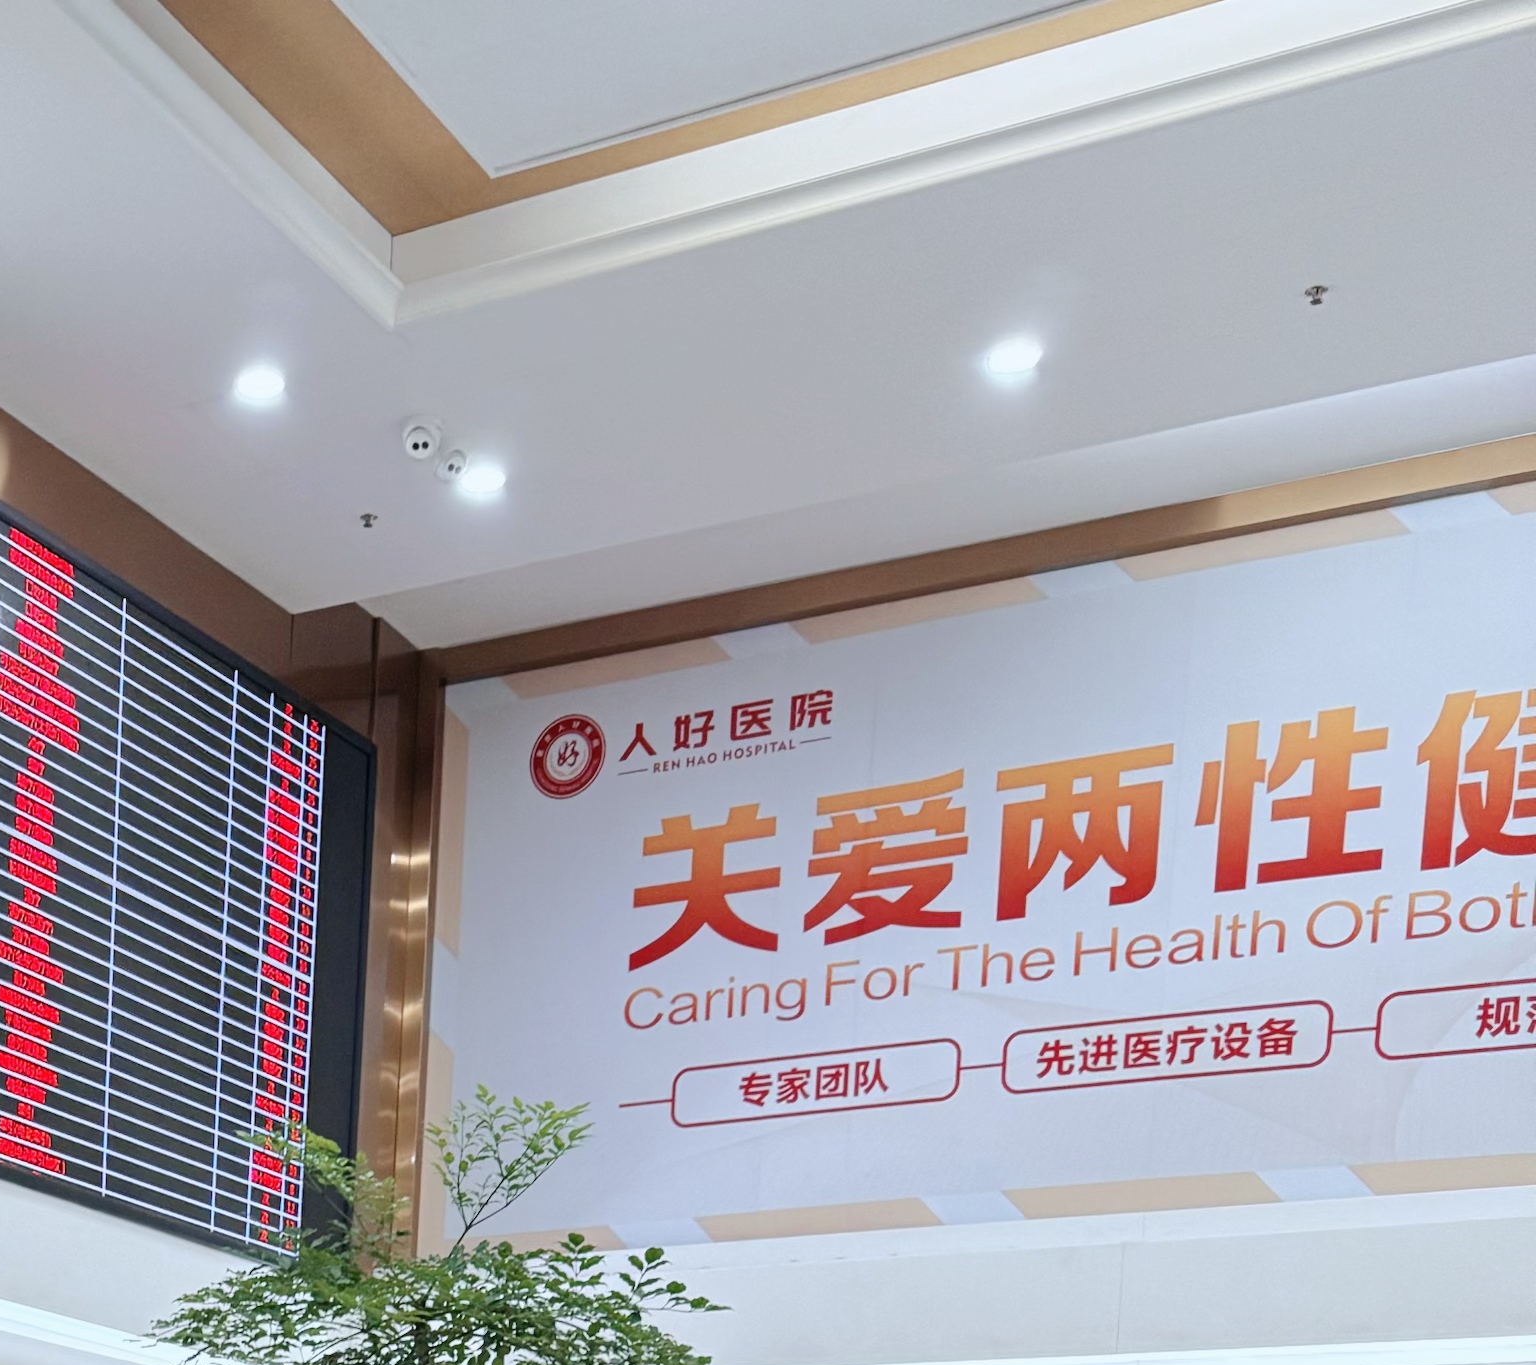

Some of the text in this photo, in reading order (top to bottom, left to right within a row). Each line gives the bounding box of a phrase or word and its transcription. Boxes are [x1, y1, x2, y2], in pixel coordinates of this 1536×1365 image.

[619, 689, 834, 762] 人好医院
[652, 739, 796, 774] REN HAO HOSPITAL
[623, 881, 1536, 1030] Caring For The Health Of Bot
[1036, 1018, 1298, 1079] 先进医疗设备
[738, 1058, 889, 1107] 专家团队
